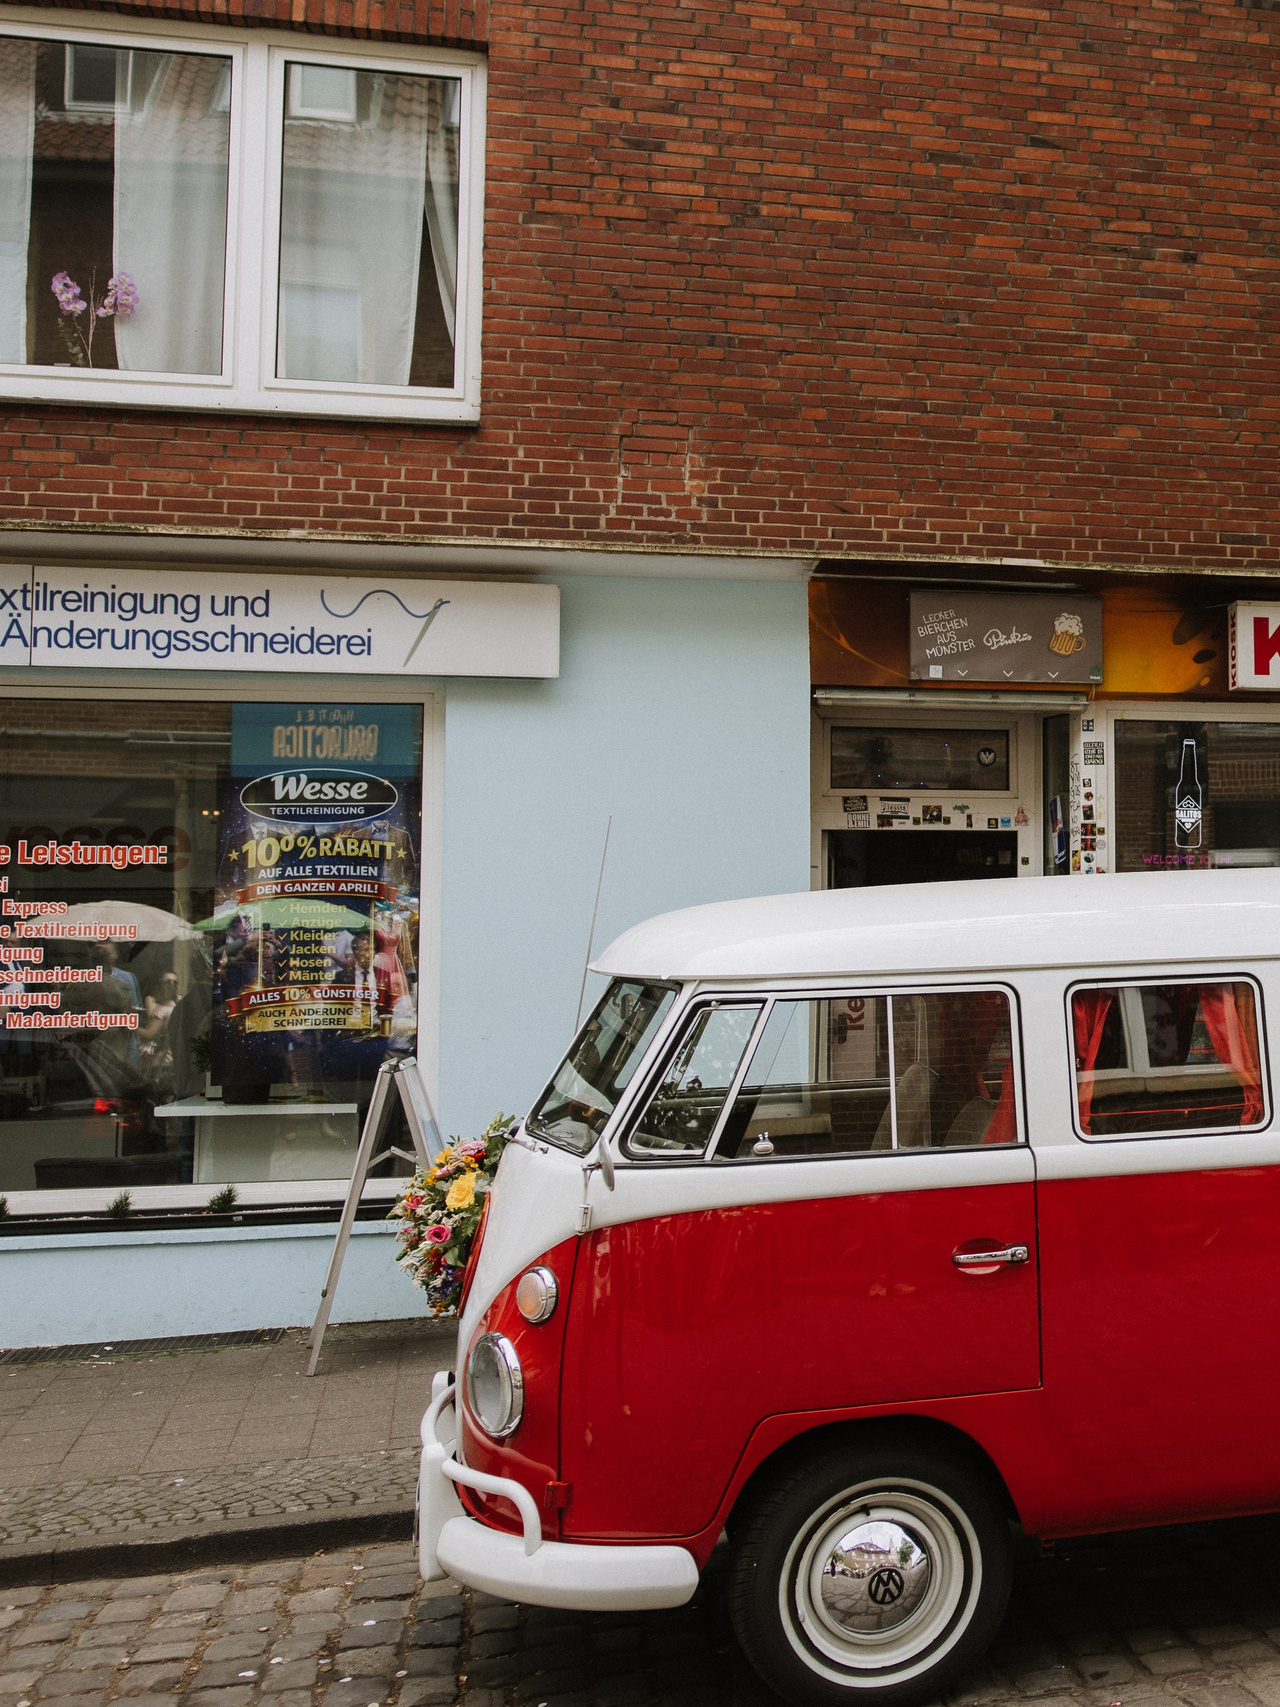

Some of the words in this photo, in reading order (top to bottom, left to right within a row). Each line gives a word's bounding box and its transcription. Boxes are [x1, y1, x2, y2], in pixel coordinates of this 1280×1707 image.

[209, 589, 270, 618] und
[922, 609, 956, 624] LECKER
[917, 617, 968, 637] BIERCHEN
[0, 611, 373, 659] Änderungsschneiderei
[936, 631, 957, 645] AUS
[926, 639, 976, 659] MÜNSTER
[270, 773, 368, 800] Wesse
[270, 806, 365, 815] TEXTILREINIGUNG
[847, 813, 870, 821] BOHNE
[1175, 809, 1202, 819] SALITOS
[18, 840, 168, 869] Leistungen:
[319, 837, 396, 860] RABATT
[1142, 854, 1195, 865] WELCOME
[1199, 855, 1211, 865] TO
[258, 867, 282, 879] AUF
[285, 866, 313, 877] ALLE
[315, 865, 378, 877] TEXTILIEN
[256, 884, 281, 896] DEN
[284, 882, 335, 892] GANZEN
[338, 882, 378, 894] APRIL!
[2, 899, 68, 918] Express
[290, 903, 347, 913] Hemden
[291, 917, 342, 929] Anzüge
[14, 921, 139, 940] Textilreinigung
[290, 930, 338, 941] Kleider
[290, 944, 337, 955] Jacken
[290, 957, 332, 967] Hosen
[289, 970, 337, 981] Mäntel
[249, 991, 280, 1005] ALLES
[282, 988, 311, 1001] 10%
[313, 988, 379, 1000] GÜNSTIGER
[258, 1009, 286, 1018] AUCH
[6, 1012, 139, 1030] Maßanfertigung
[274, 1018, 346, 1028] SCHNEIDEREI
